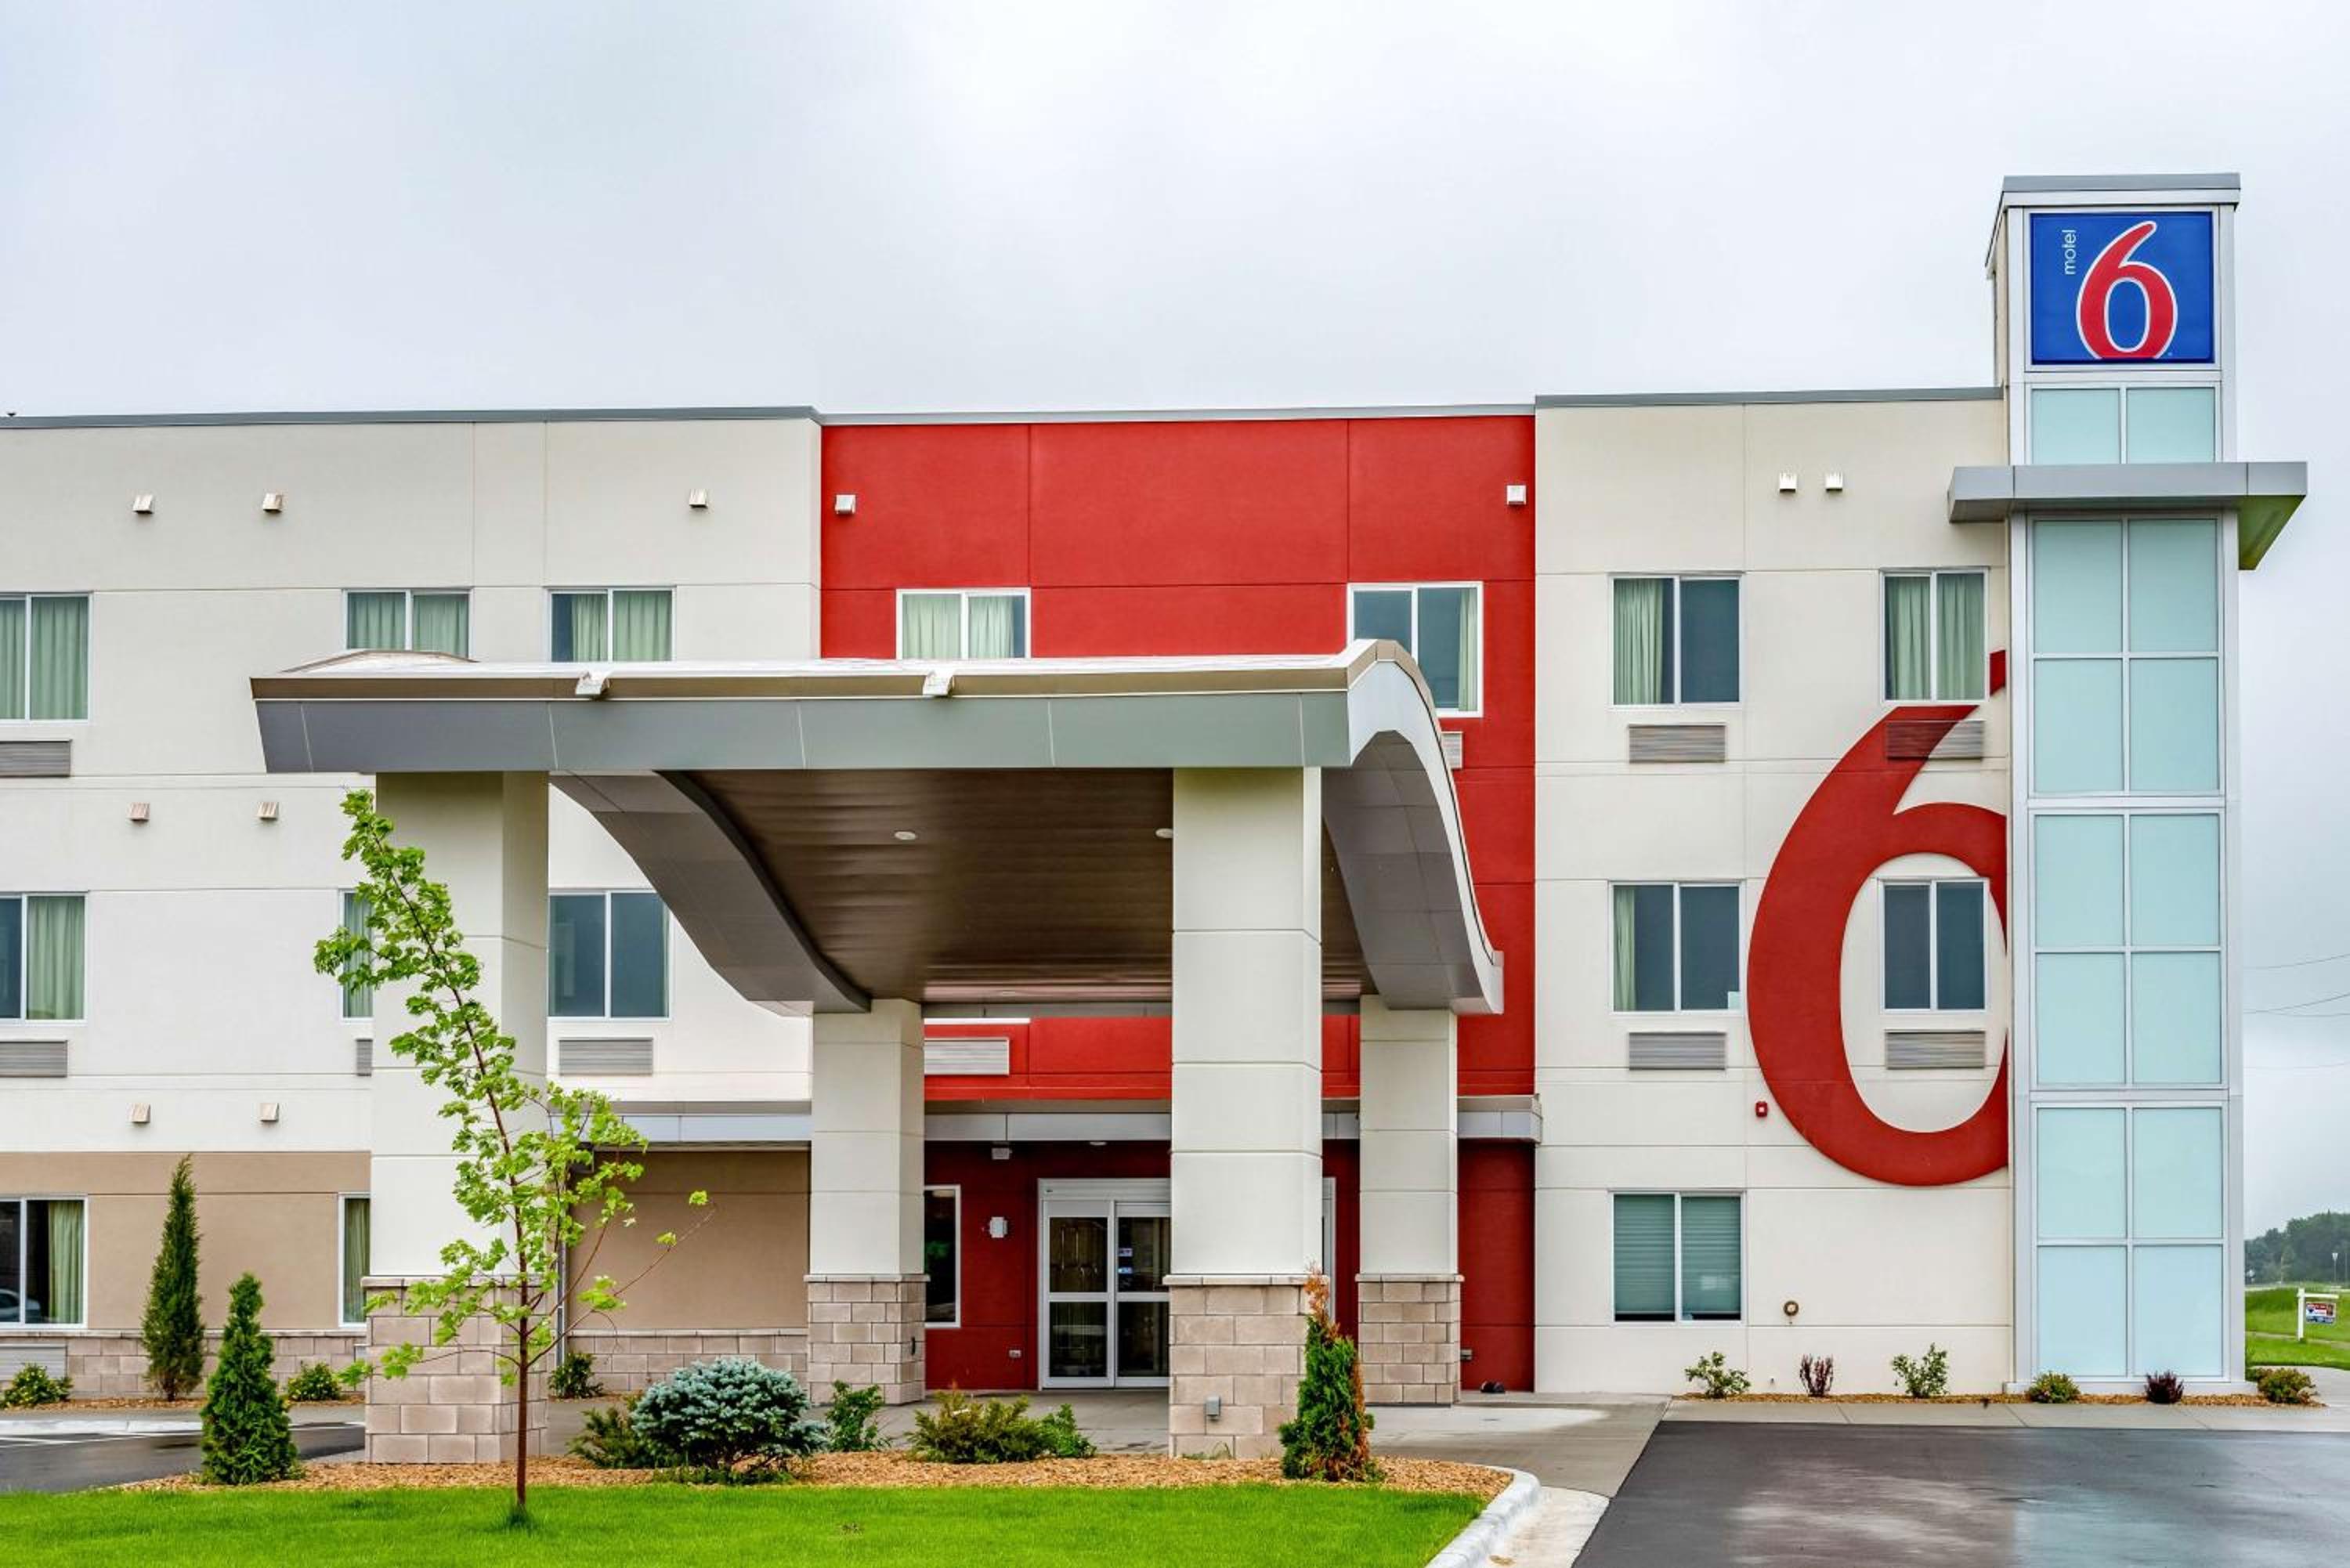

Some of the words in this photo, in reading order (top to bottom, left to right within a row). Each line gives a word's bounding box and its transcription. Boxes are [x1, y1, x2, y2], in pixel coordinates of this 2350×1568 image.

[2061, 229, 2077, 275] motel
[2076, 220, 2178, 359] 6
[1748, 649, 2009, 1187] 6
